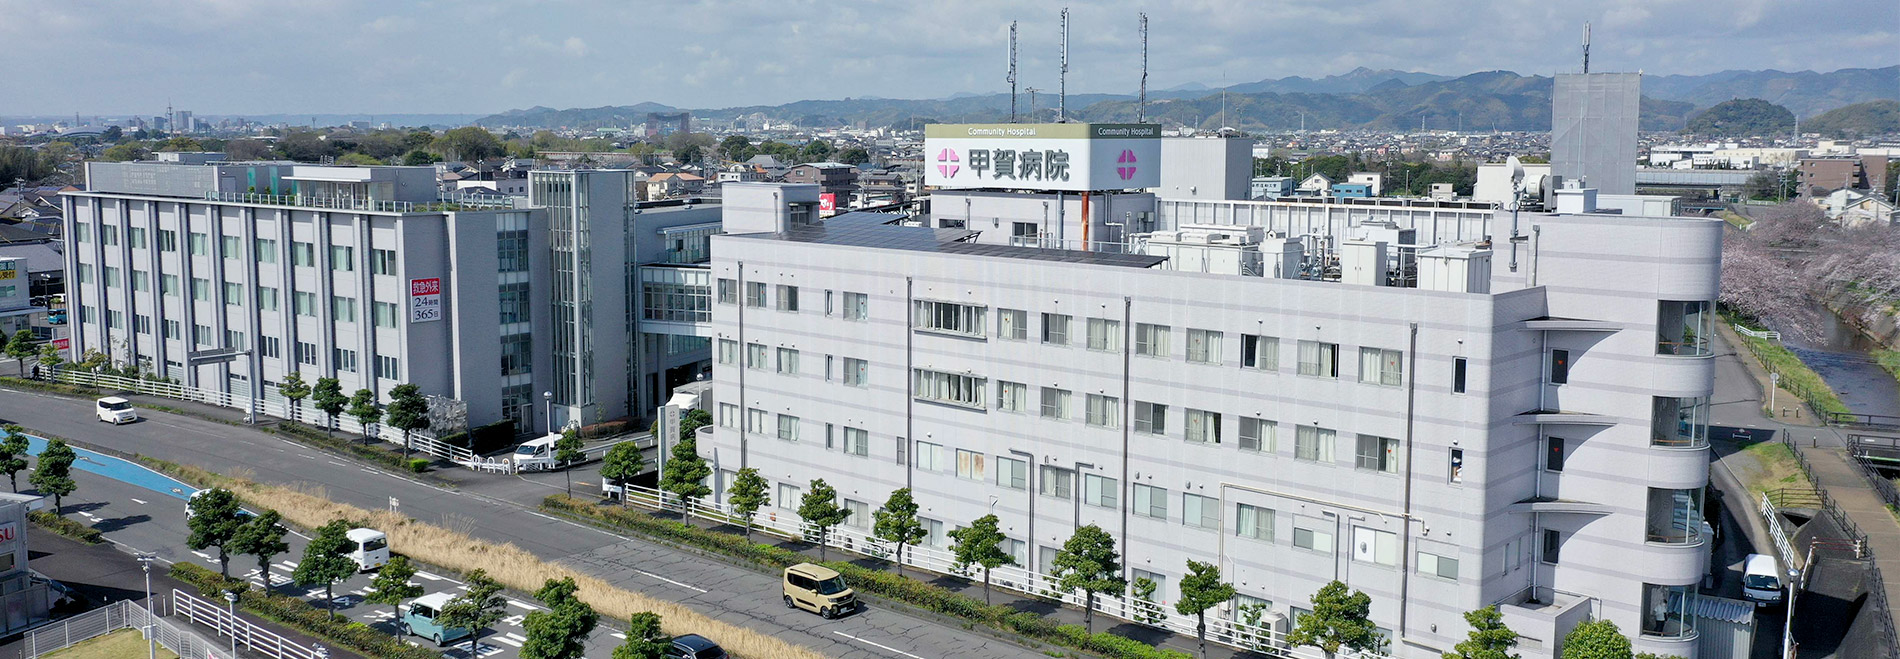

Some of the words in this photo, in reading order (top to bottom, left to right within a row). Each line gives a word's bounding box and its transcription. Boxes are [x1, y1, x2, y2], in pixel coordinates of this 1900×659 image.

[967, 127, 1005, 137] Community
[1007, 127, 1036, 136] Hospital
[1097, 127, 1130, 137] Community
[1131, 127, 1154, 136] Hospital
[968, 148, 1070, 182] 甲賀病院
[413, 281, 438, 294] 救急外来
[415, 297, 438, 307] 24時間
[415, 309, 438, 320] 365日
